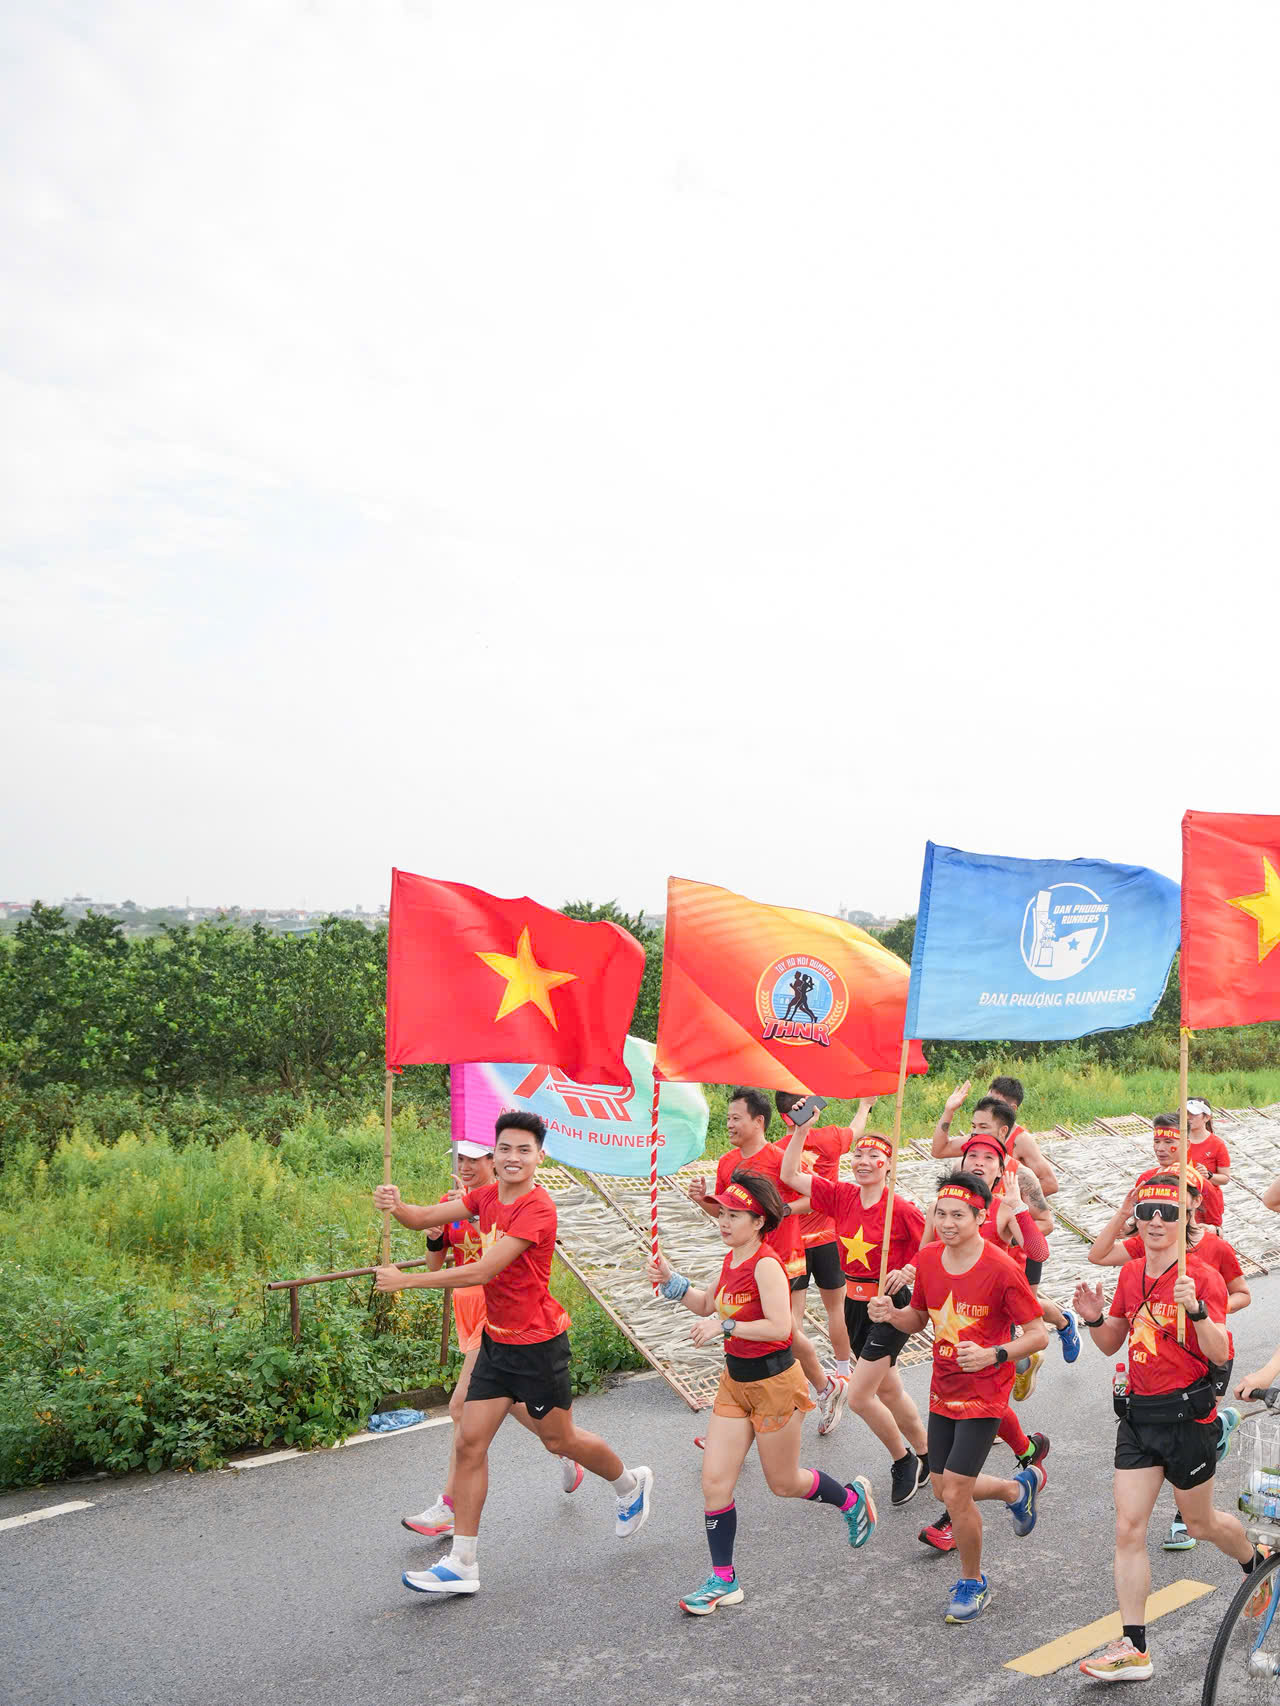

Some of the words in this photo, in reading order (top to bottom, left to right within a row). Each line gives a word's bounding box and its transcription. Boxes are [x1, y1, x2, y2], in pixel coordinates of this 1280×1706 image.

[1062, 914, 1100, 924] RUNNERS
[1064, 987, 1137, 1008] RUNNERS
[762, 1016, 830, 1047] THNR
[527, 1112, 584, 1141] HÁNH
